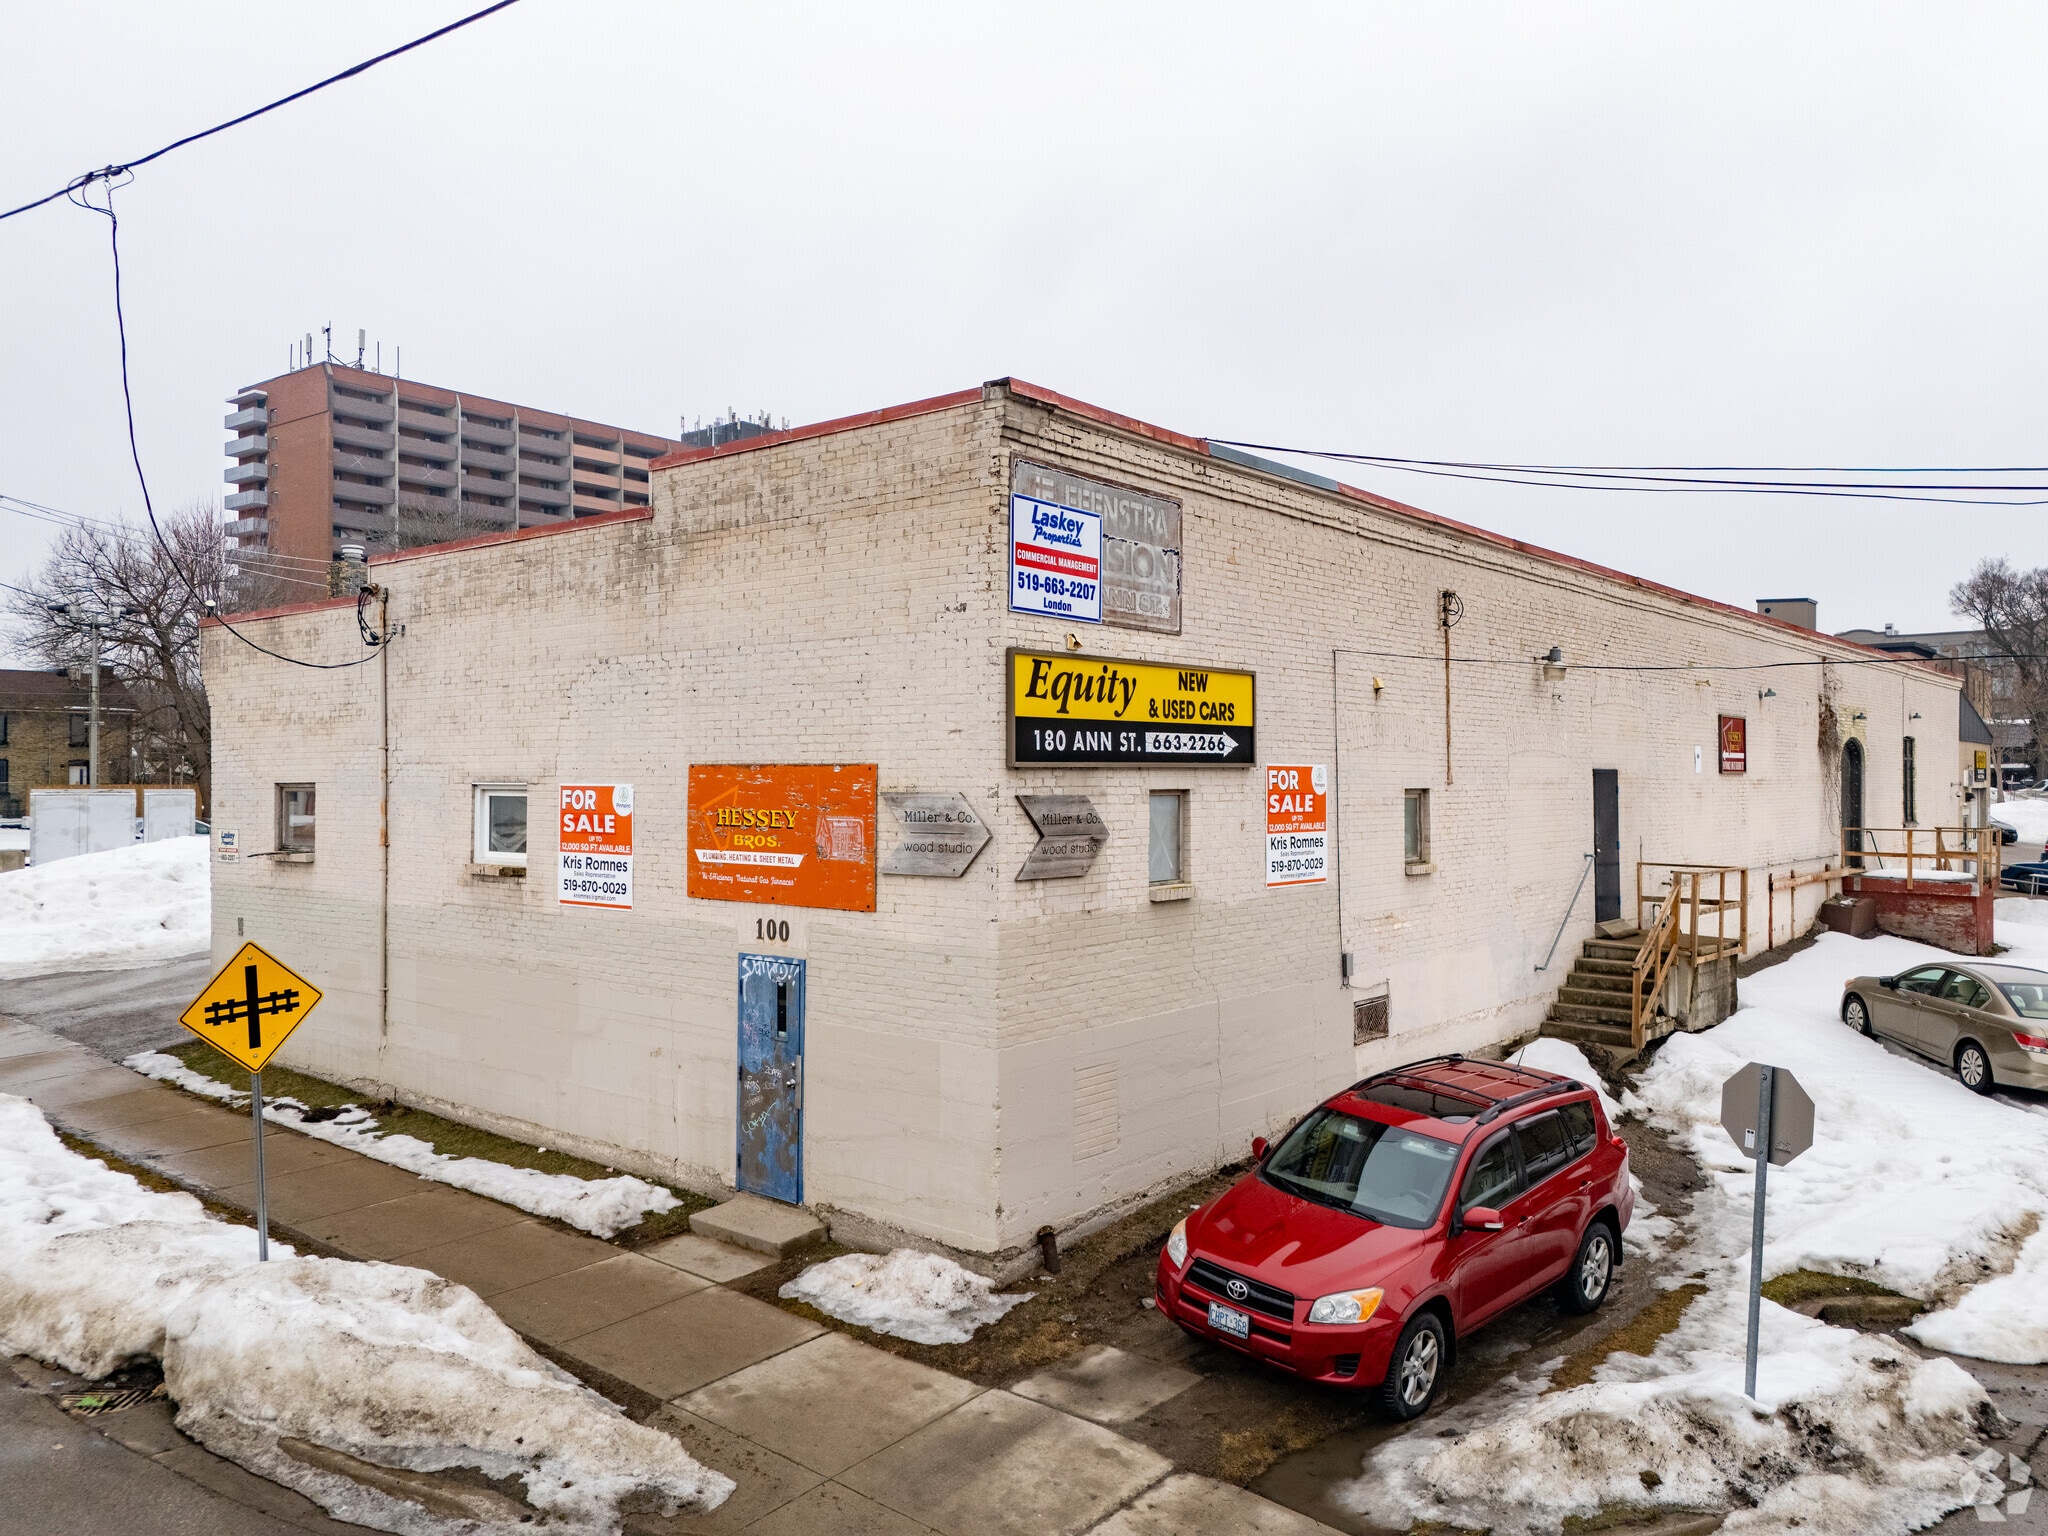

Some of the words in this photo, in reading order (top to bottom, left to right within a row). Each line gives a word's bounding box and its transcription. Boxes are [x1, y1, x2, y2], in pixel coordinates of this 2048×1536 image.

[1031, 504, 1084, 537] Laskey
[1032, 525, 1082, 547] Properties
[1017, 549, 1057, 566] COMMERCIAL
[1058, 558, 1097, 573] MANAGEMENT
[1018, 571, 1096, 601] 519-663-2207
[1043, 597, 1072, 612] London
[1025, 658, 1137, 718] Equity
[1178, 671, 1208, 692] NEW
[1148, 698, 1159, 719] &
[1162, 699, 1195, 720] USED
[1200, 702, 1235, 722] CARS
[1034, 729, 1067, 751] 180
[1072, 731, 1112, 751] ANN
[1119, 732, 1141, 752] ST.
[1152, 734, 1226, 751] 663-2266
[1268, 770, 1299, 790] FOR
[562, 789, 597, 810] FOR
[1269, 794, 1314, 813] SALE
[563, 814, 615, 833] SALE
[717, 808, 798, 829] HESSEY
[904, 810, 940, 823] Miller
[945, 813, 953, 823] &
[957, 811, 976, 824] Co.
[1042, 813, 1073, 826] Miller
[1076, 814, 1083, 824] &
[1086, 812, 1101, 824] Co.
[1268, 823, 1284, 832] 12,000
[1285, 823, 1292, 831] SQ
[1300, 822, 1325, 830] AVAILABLE
[562, 842, 579, 852] 12,000
[590, 844, 598, 852] FT
[599, 845, 631, 853] AVAILABLE
[734, 834, 781, 849] BROS.
[903, 841, 934, 853] wood
[937, 842, 973, 854] studio
[1041, 843, 1067, 855] wood
[1070, 843, 1098, 854] studio
[1270, 836, 1287, 850] Kris
[1290, 836, 1324, 849] Romnes
[563, 855, 582, 869] Kris
[585, 857, 628, 872] Romnes
[729, 853, 751, 862] HEATING
[759, 856, 776, 864] SHEET
[777, 857, 795, 865] METAL
[1271, 858, 1324, 872] 519-870-0029
[563, 879, 627, 895] 519-870-0029
[759, 875, 769, 884] Gas
[756, 918, 790, 943] 100
